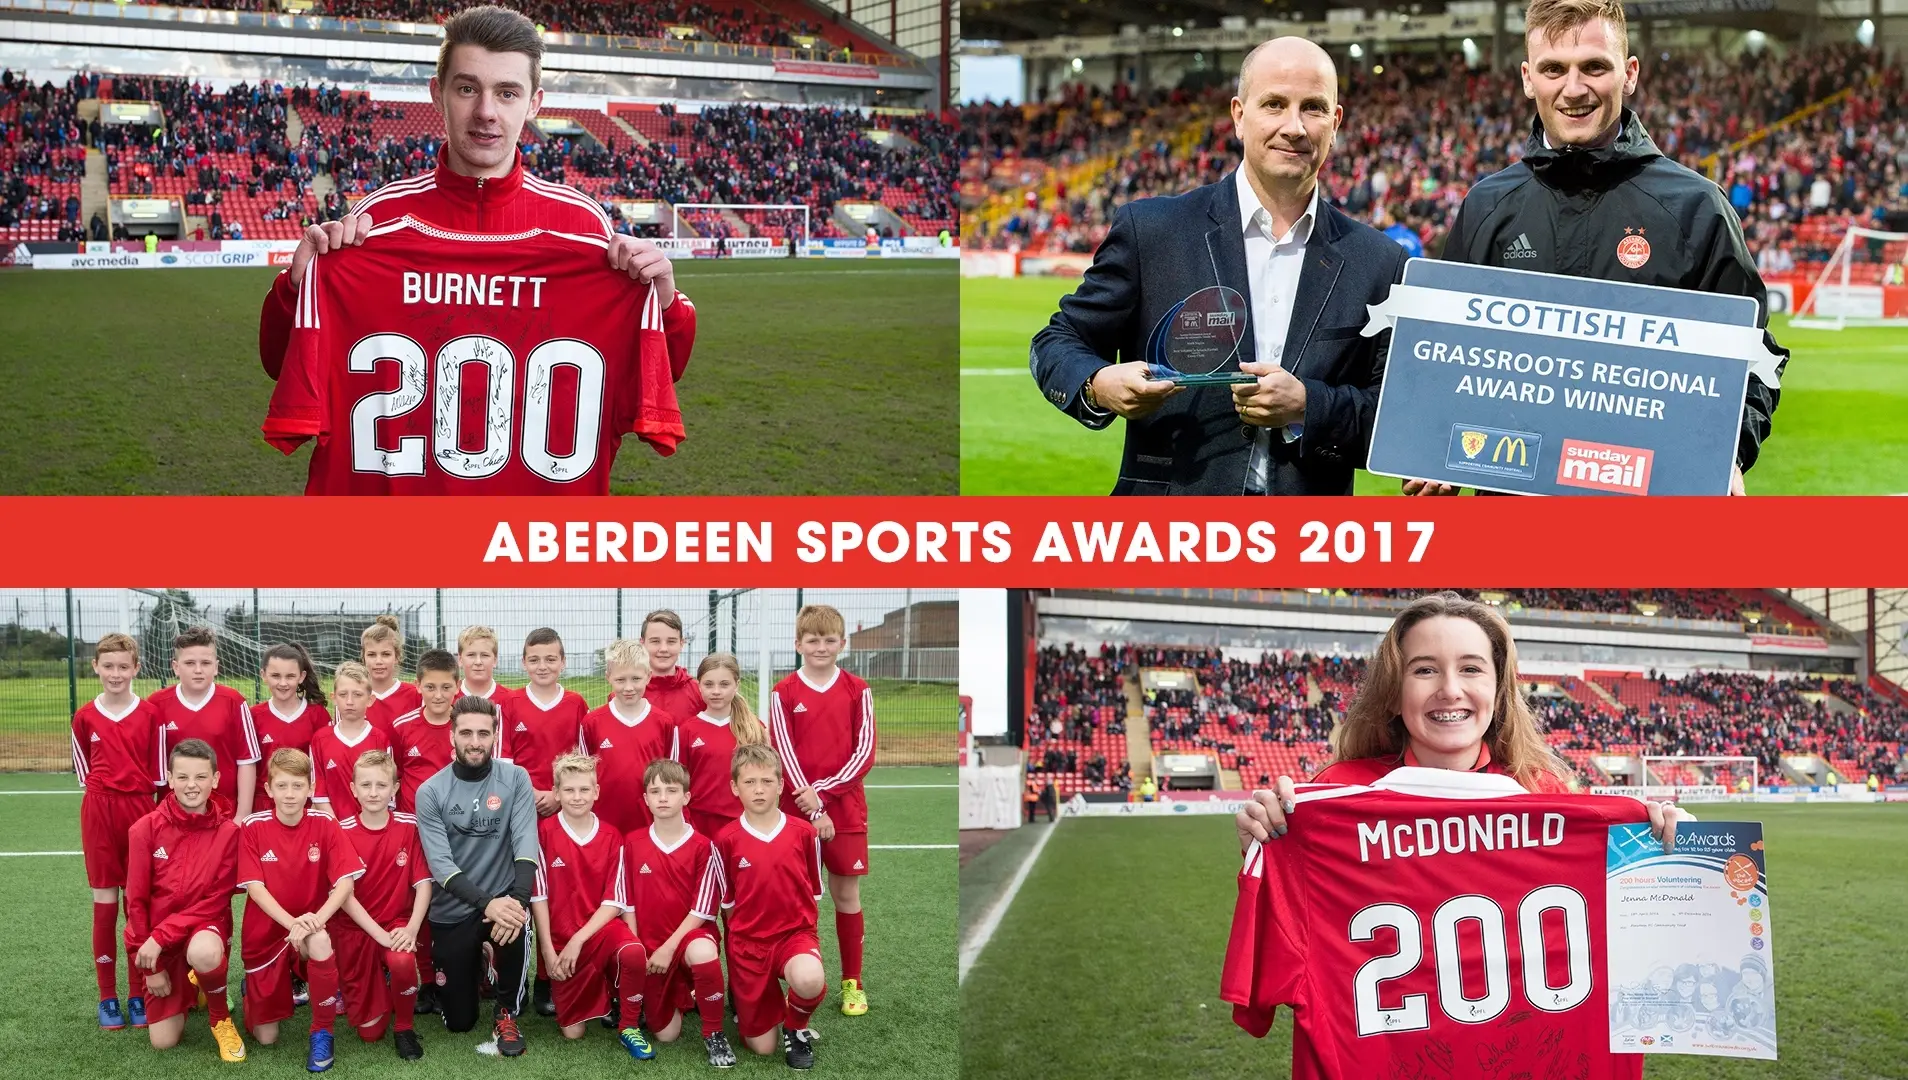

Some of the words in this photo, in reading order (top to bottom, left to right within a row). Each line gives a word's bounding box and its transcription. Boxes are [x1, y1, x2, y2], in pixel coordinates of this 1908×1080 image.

[72, 256, 95, 267] avc
[98, 255, 139, 266] media
[1503, 249, 1538, 260] adidas
[403, 271, 547, 308] BURNETT
[1208, 312, 1235, 325] mail
[1465, 297, 1627, 340] SCOTTISH
[1639, 318, 1680, 347] FA
[1412, 339, 1586, 381] GRASSROOTS
[1591, 361, 1722, 399] REGIONAL
[348, 332, 606, 483] 200
[1454, 374, 1556, 406] AWARD
[1563, 387, 1666, 421] WINNER
[1566, 446, 1632, 466] sunday
[1562, 456, 1647, 489] mail
[472, 798, 480, 812] 3
[1357, 812, 1566, 863] McDONALD
[1685, 831, 1737, 847] Awards
[1619, 877, 1633, 885] 200
[1633, 876, 1656, 885] hours
[1656, 875, 1702, 886] Volunteering
[1620, 894, 1649, 903] Jenna
[1649, 893, 1695, 902] McDonald
[1348, 883, 1594, 1038] 200
